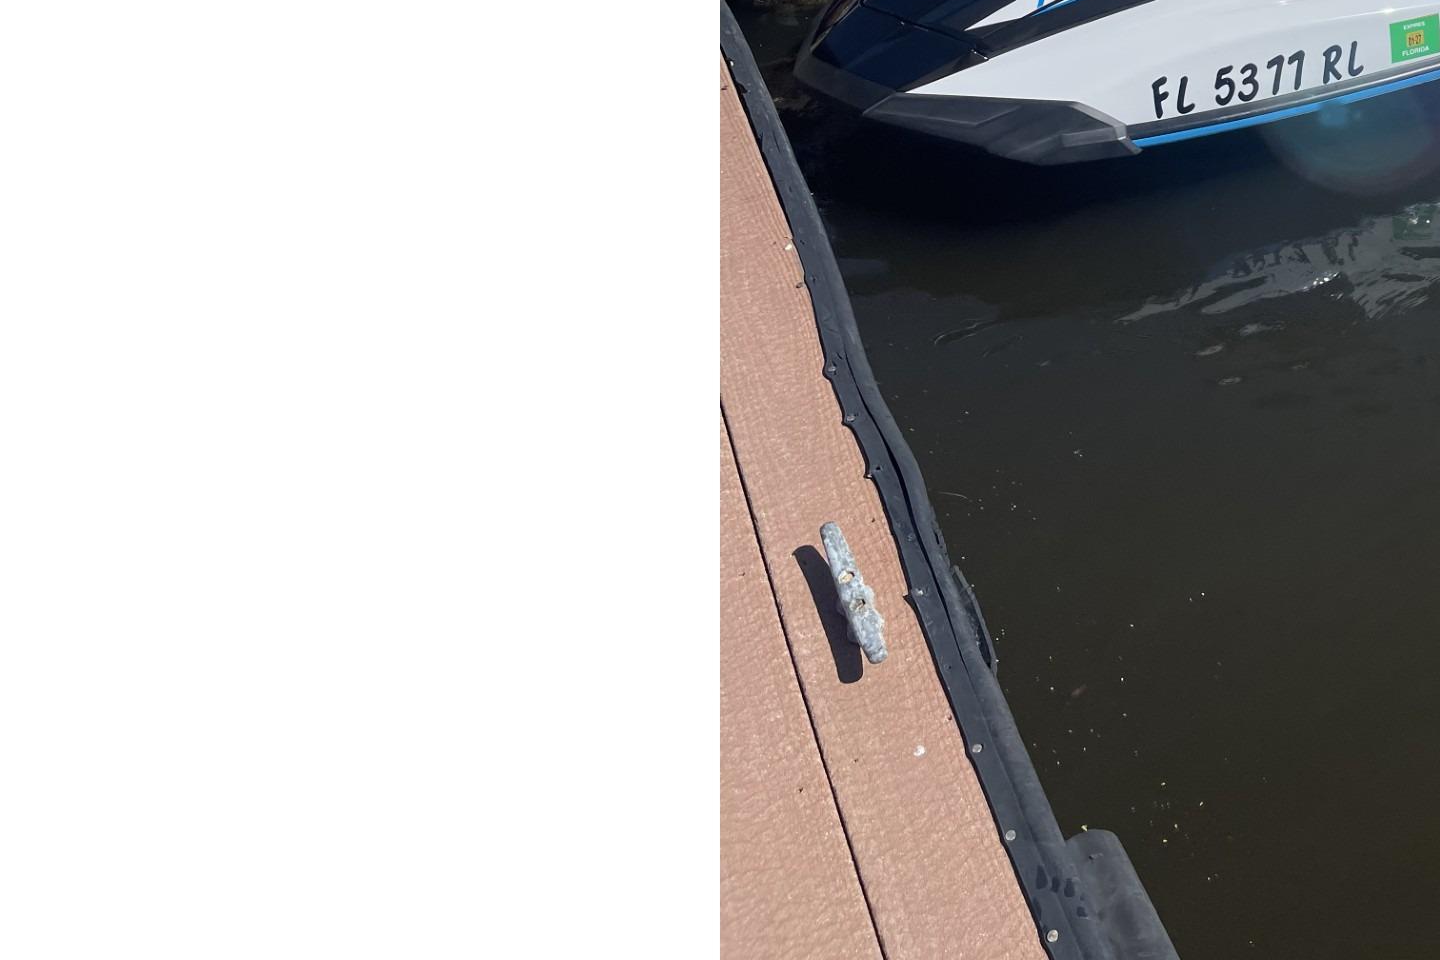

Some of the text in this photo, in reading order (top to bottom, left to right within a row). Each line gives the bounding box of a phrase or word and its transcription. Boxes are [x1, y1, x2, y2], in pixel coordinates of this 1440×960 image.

[1402, 45, 1429, 57] FLORIDA
[1152, 75, 1196, 120] FL
[1322, 40, 1365, 85] RL
